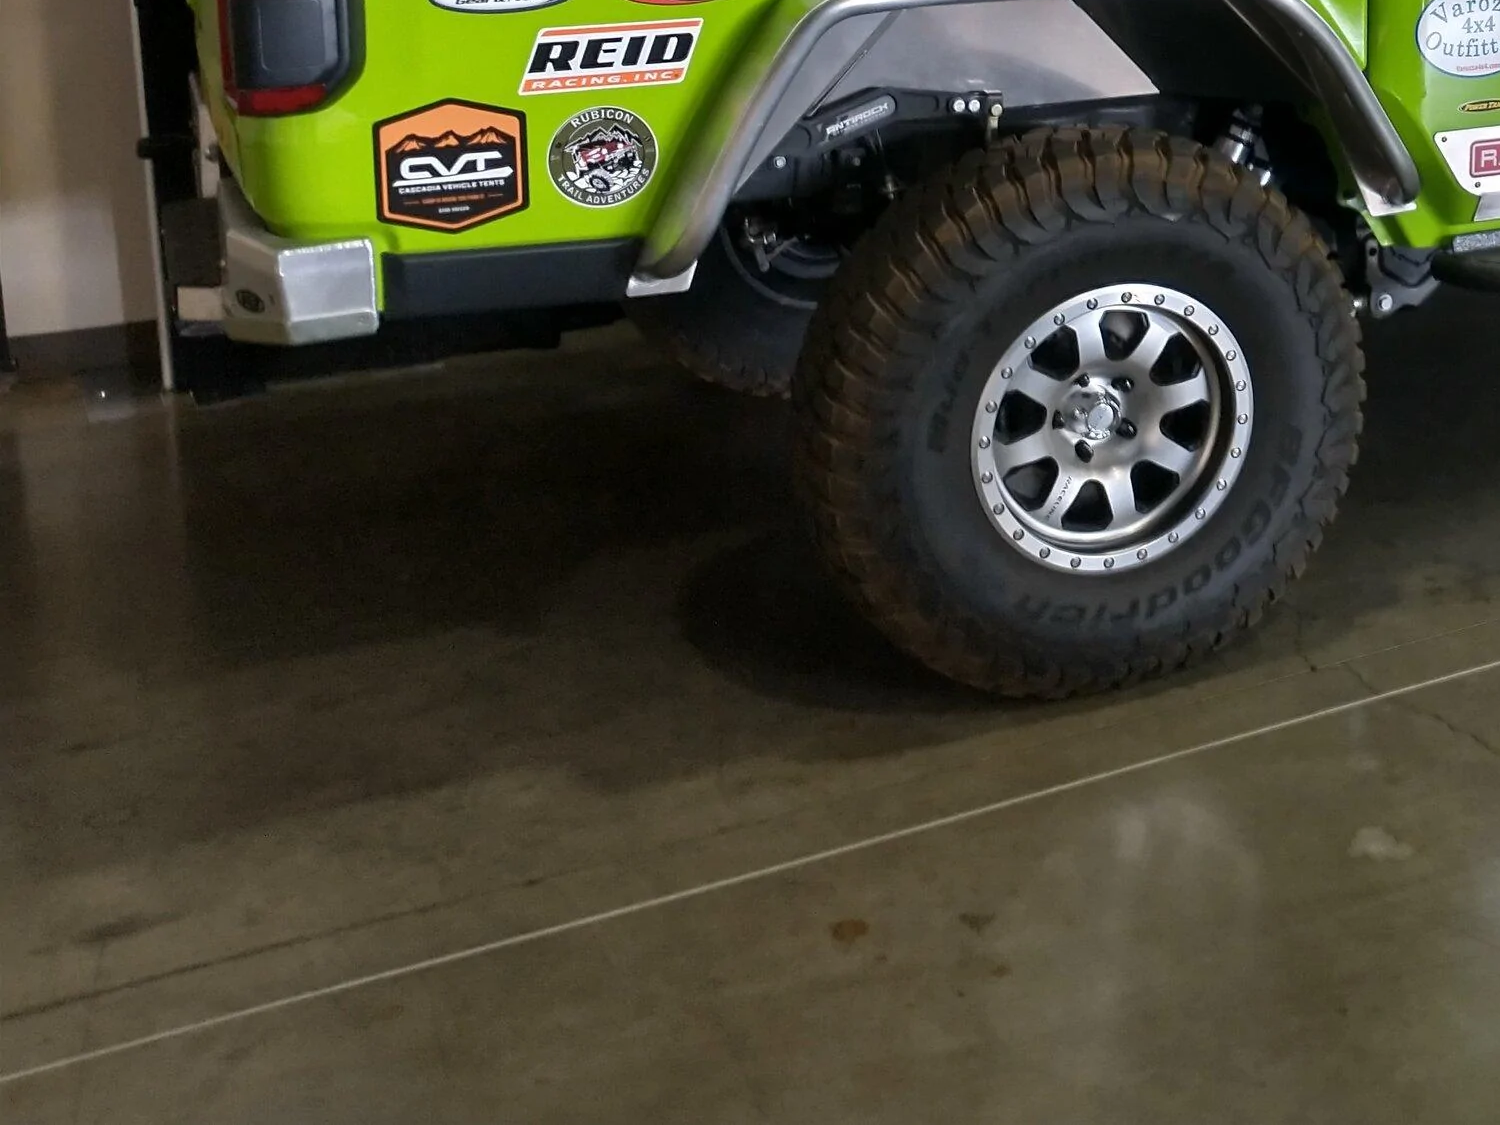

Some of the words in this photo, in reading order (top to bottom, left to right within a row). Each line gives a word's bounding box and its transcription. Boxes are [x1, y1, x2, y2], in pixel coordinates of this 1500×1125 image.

[1462, 15, 1496, 35] 4x4
[528, 32, 693, 74] REID
[571, 109, 634, 128] RUBICON
[826, 103, 889, 136] ANTIROCK
[400, 151, 503, 180] CVT
[398, 184, 441, 195] CASCADIA
[441, 181, 478, 190] VEHICLE
[479, 179, 506, 187] TENTS
[557, 174, 584, 201] TRAIL
[586, 168, 651, 204] ADVENTURES
